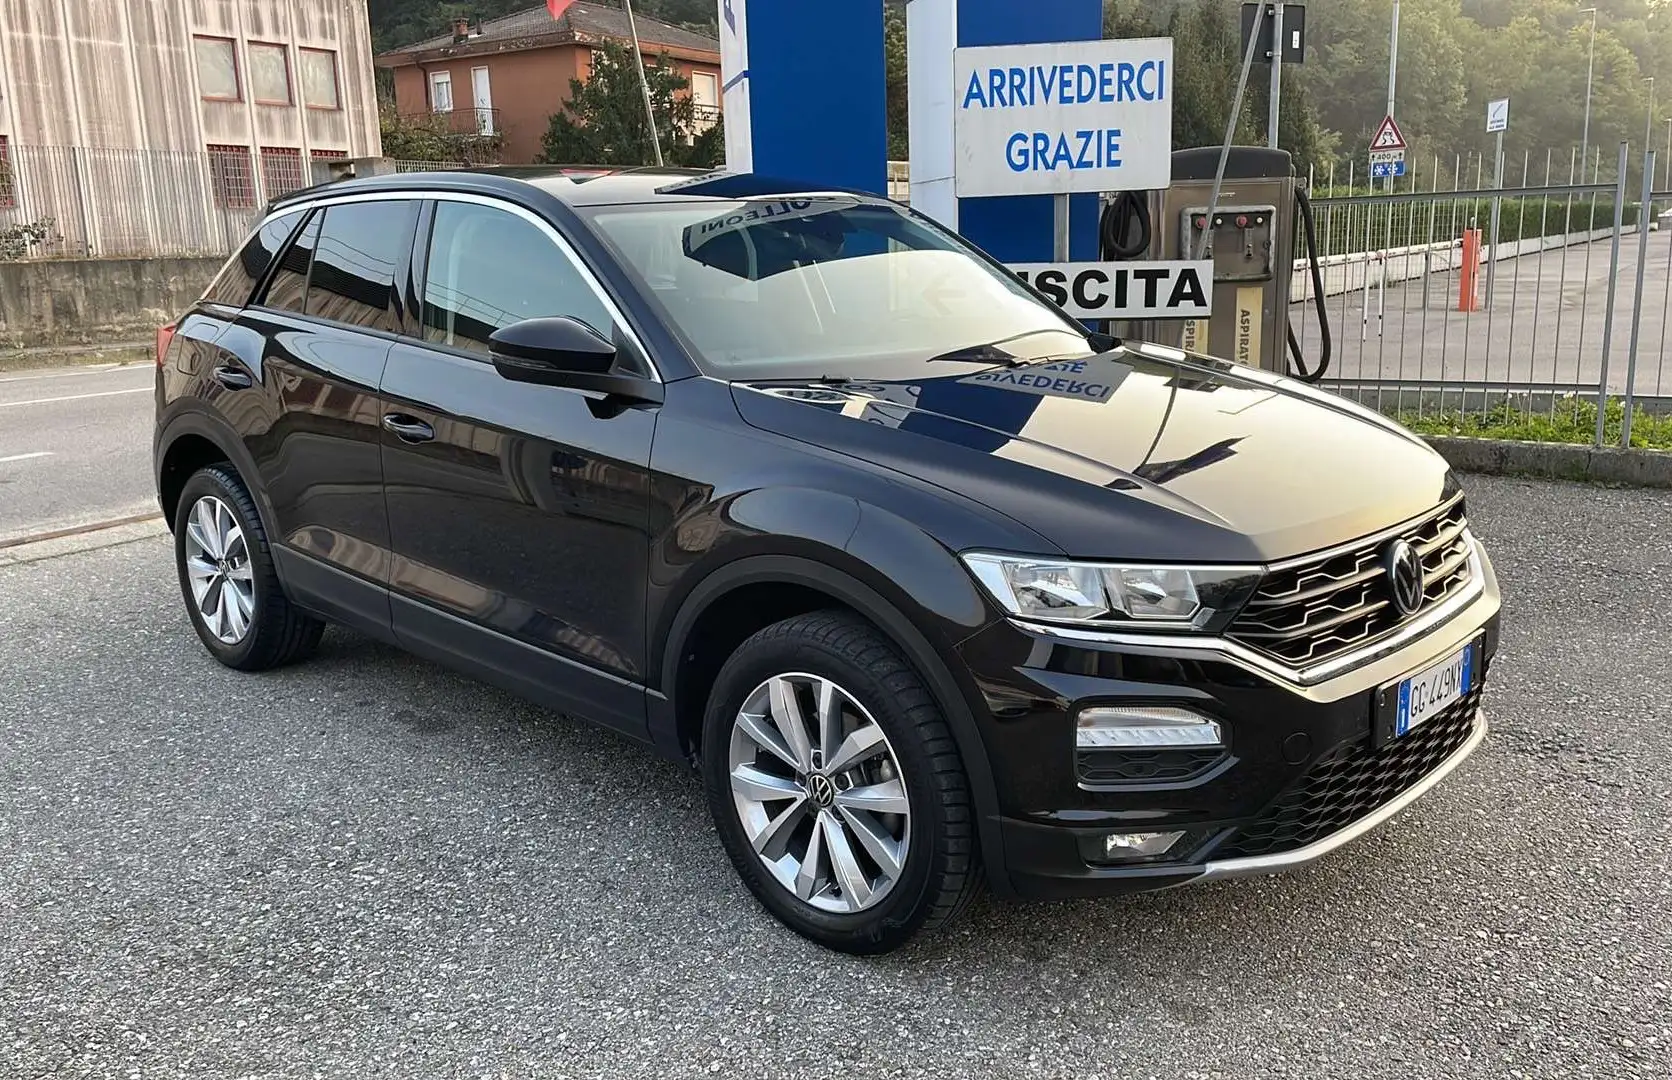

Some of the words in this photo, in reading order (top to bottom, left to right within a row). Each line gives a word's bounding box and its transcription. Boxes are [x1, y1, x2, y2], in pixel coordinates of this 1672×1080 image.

[963, 60, 1164, 108] ARRIVEDERCI
[1006, 129, 1122, 172] GRAZIE
[1017, 268, 1208, 309] SCITA
